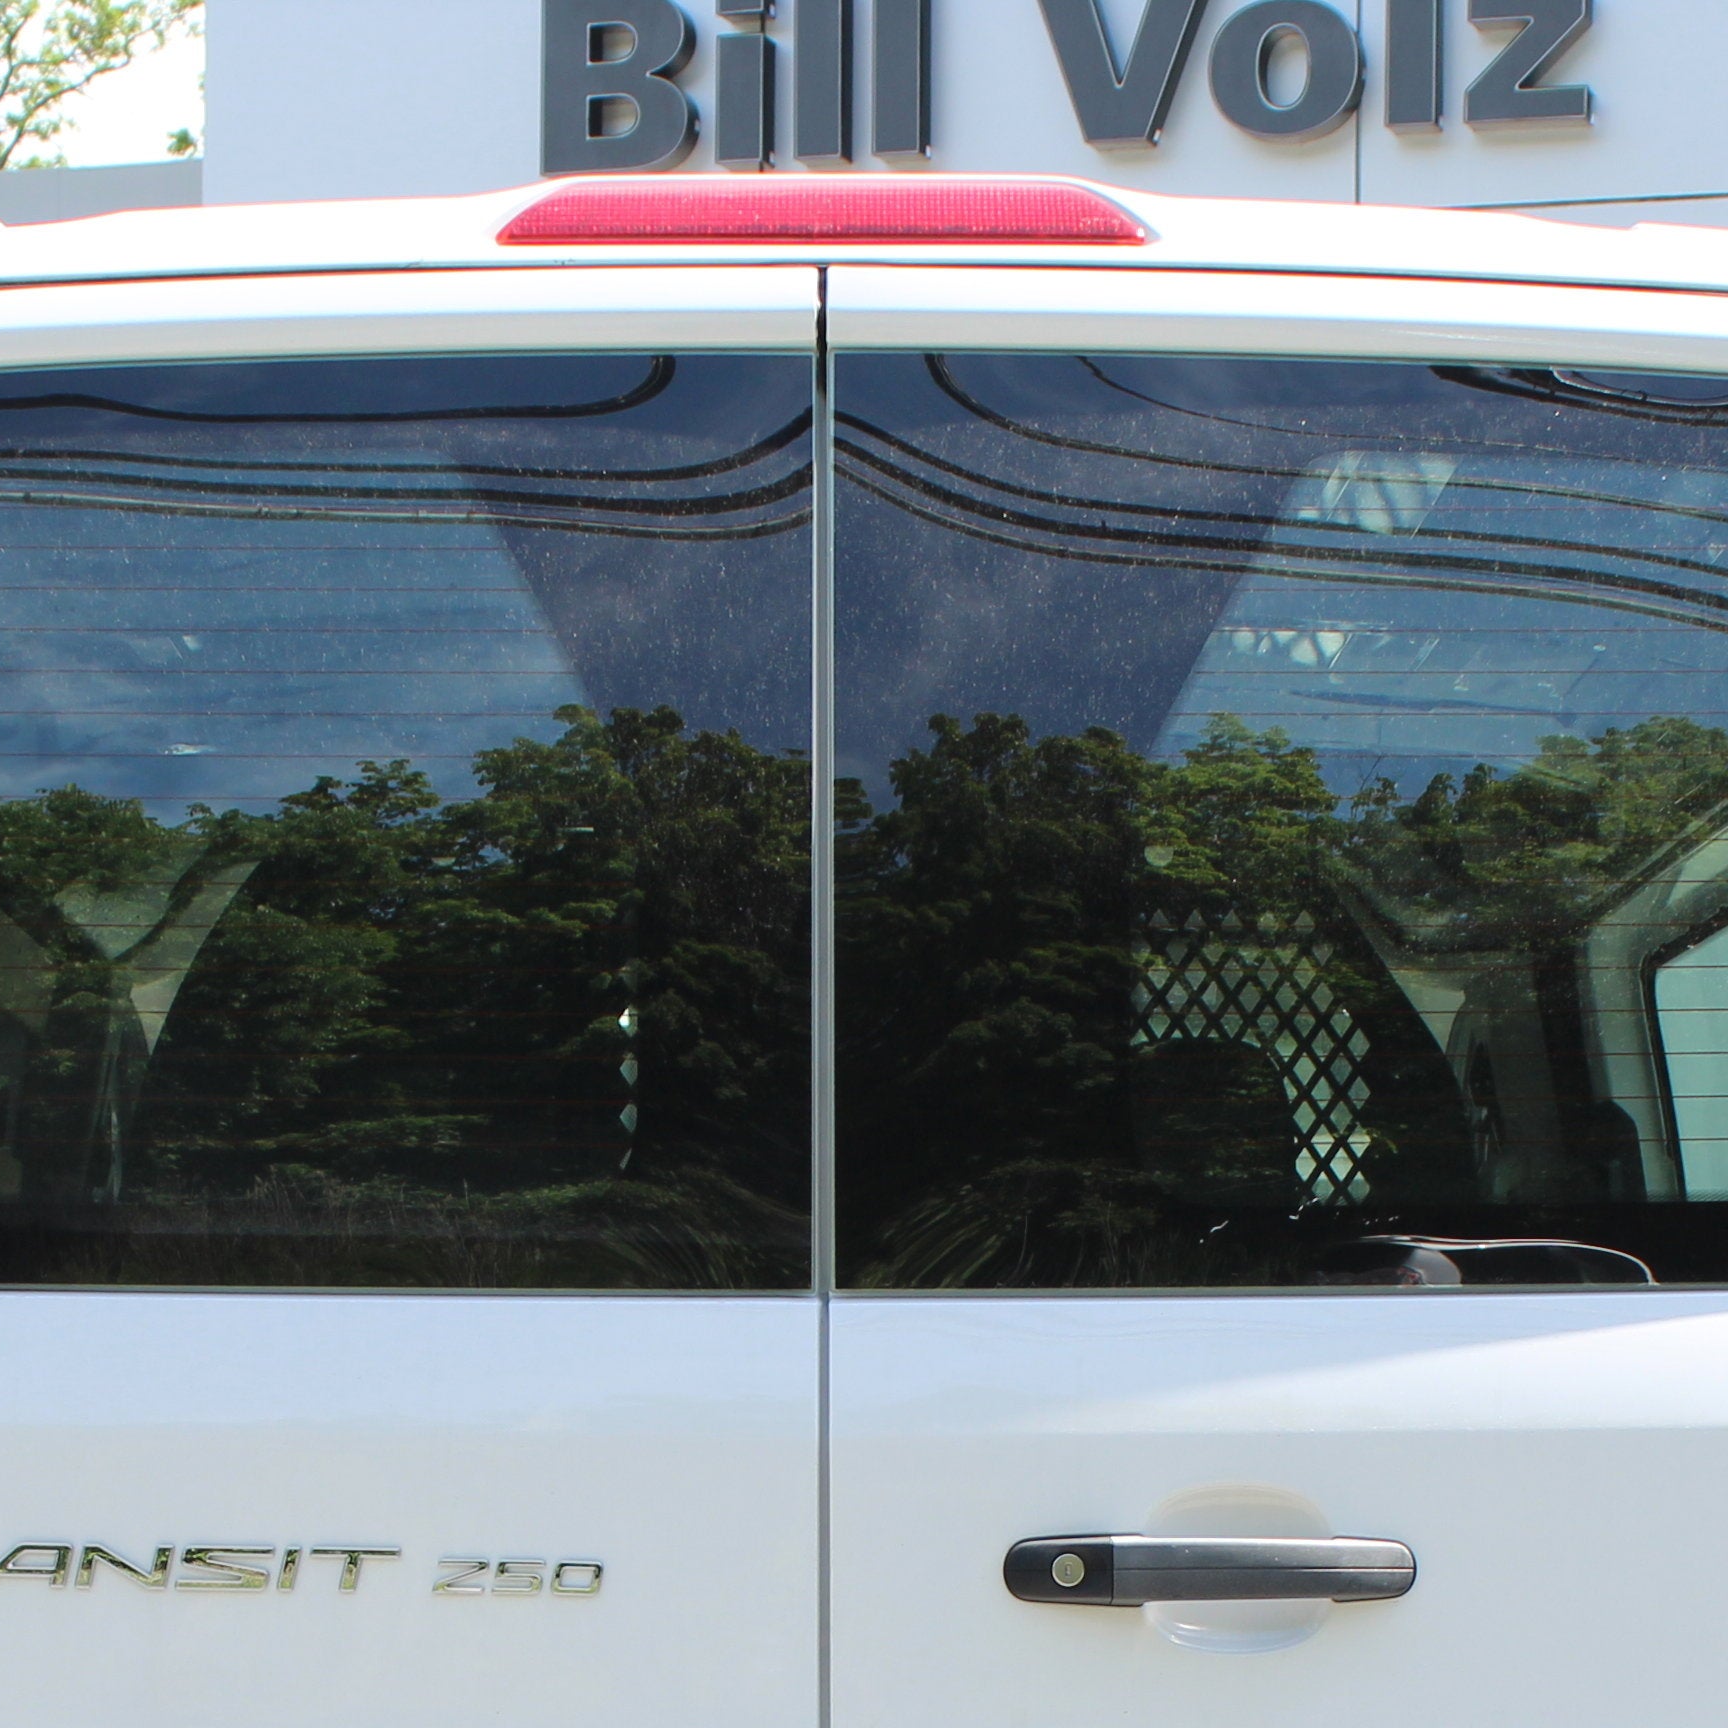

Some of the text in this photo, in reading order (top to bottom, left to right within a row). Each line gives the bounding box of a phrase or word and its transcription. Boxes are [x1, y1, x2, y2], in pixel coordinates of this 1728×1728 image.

[540, 0, 1596, 177] Bill Volz
[432, 1555, 605, 1597] 250
